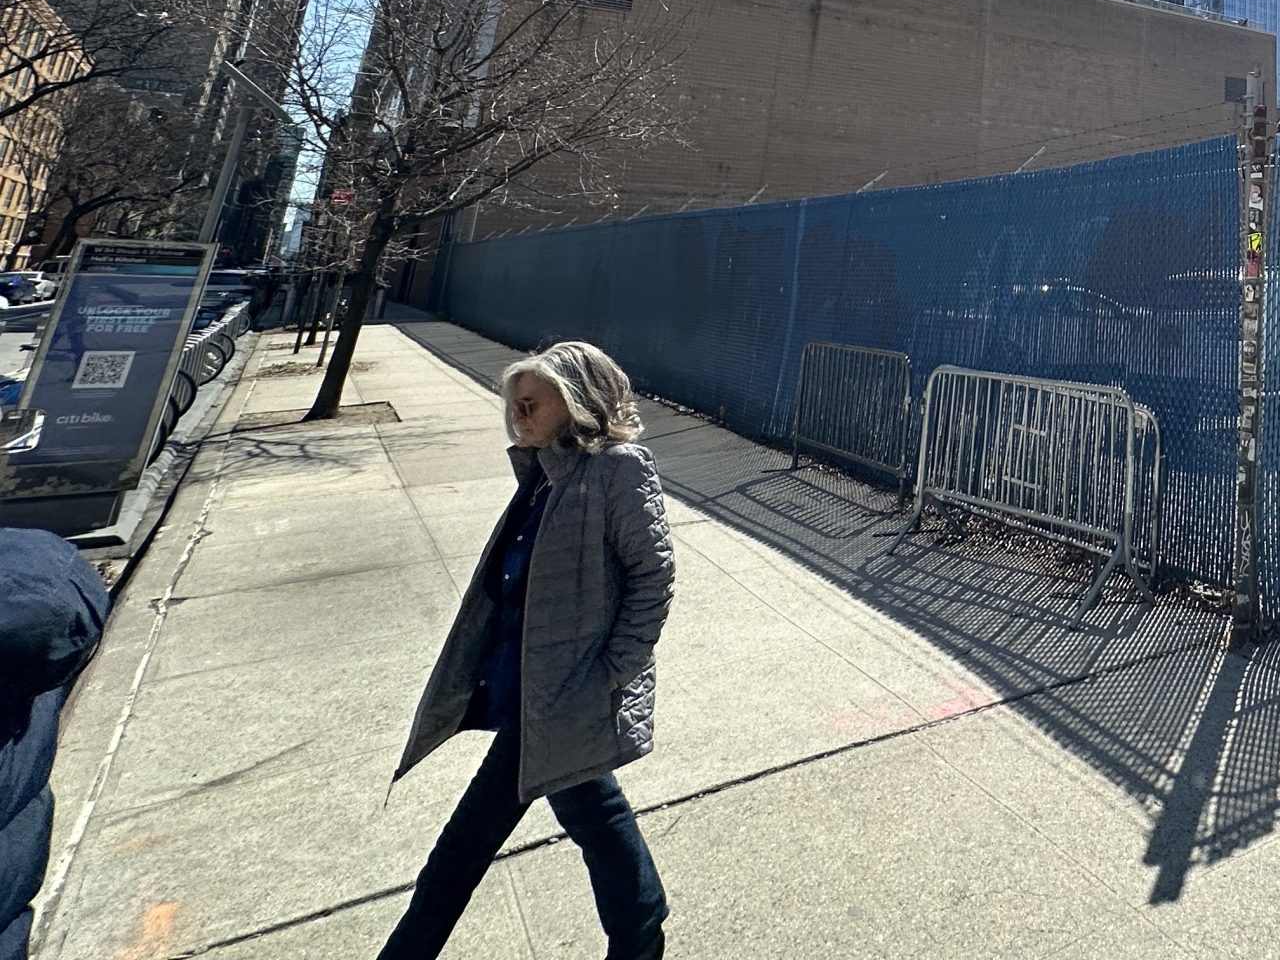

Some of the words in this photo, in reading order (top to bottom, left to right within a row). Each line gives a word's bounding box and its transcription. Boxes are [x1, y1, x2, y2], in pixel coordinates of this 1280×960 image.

[77, 306, 132, 315] UNLOCK
[136, 307, 171, 316] YOUR
[86, 324, 112, 333] FOR
[117, 324, 149, 332] FREE
[81, 412, 113, 423] bike
